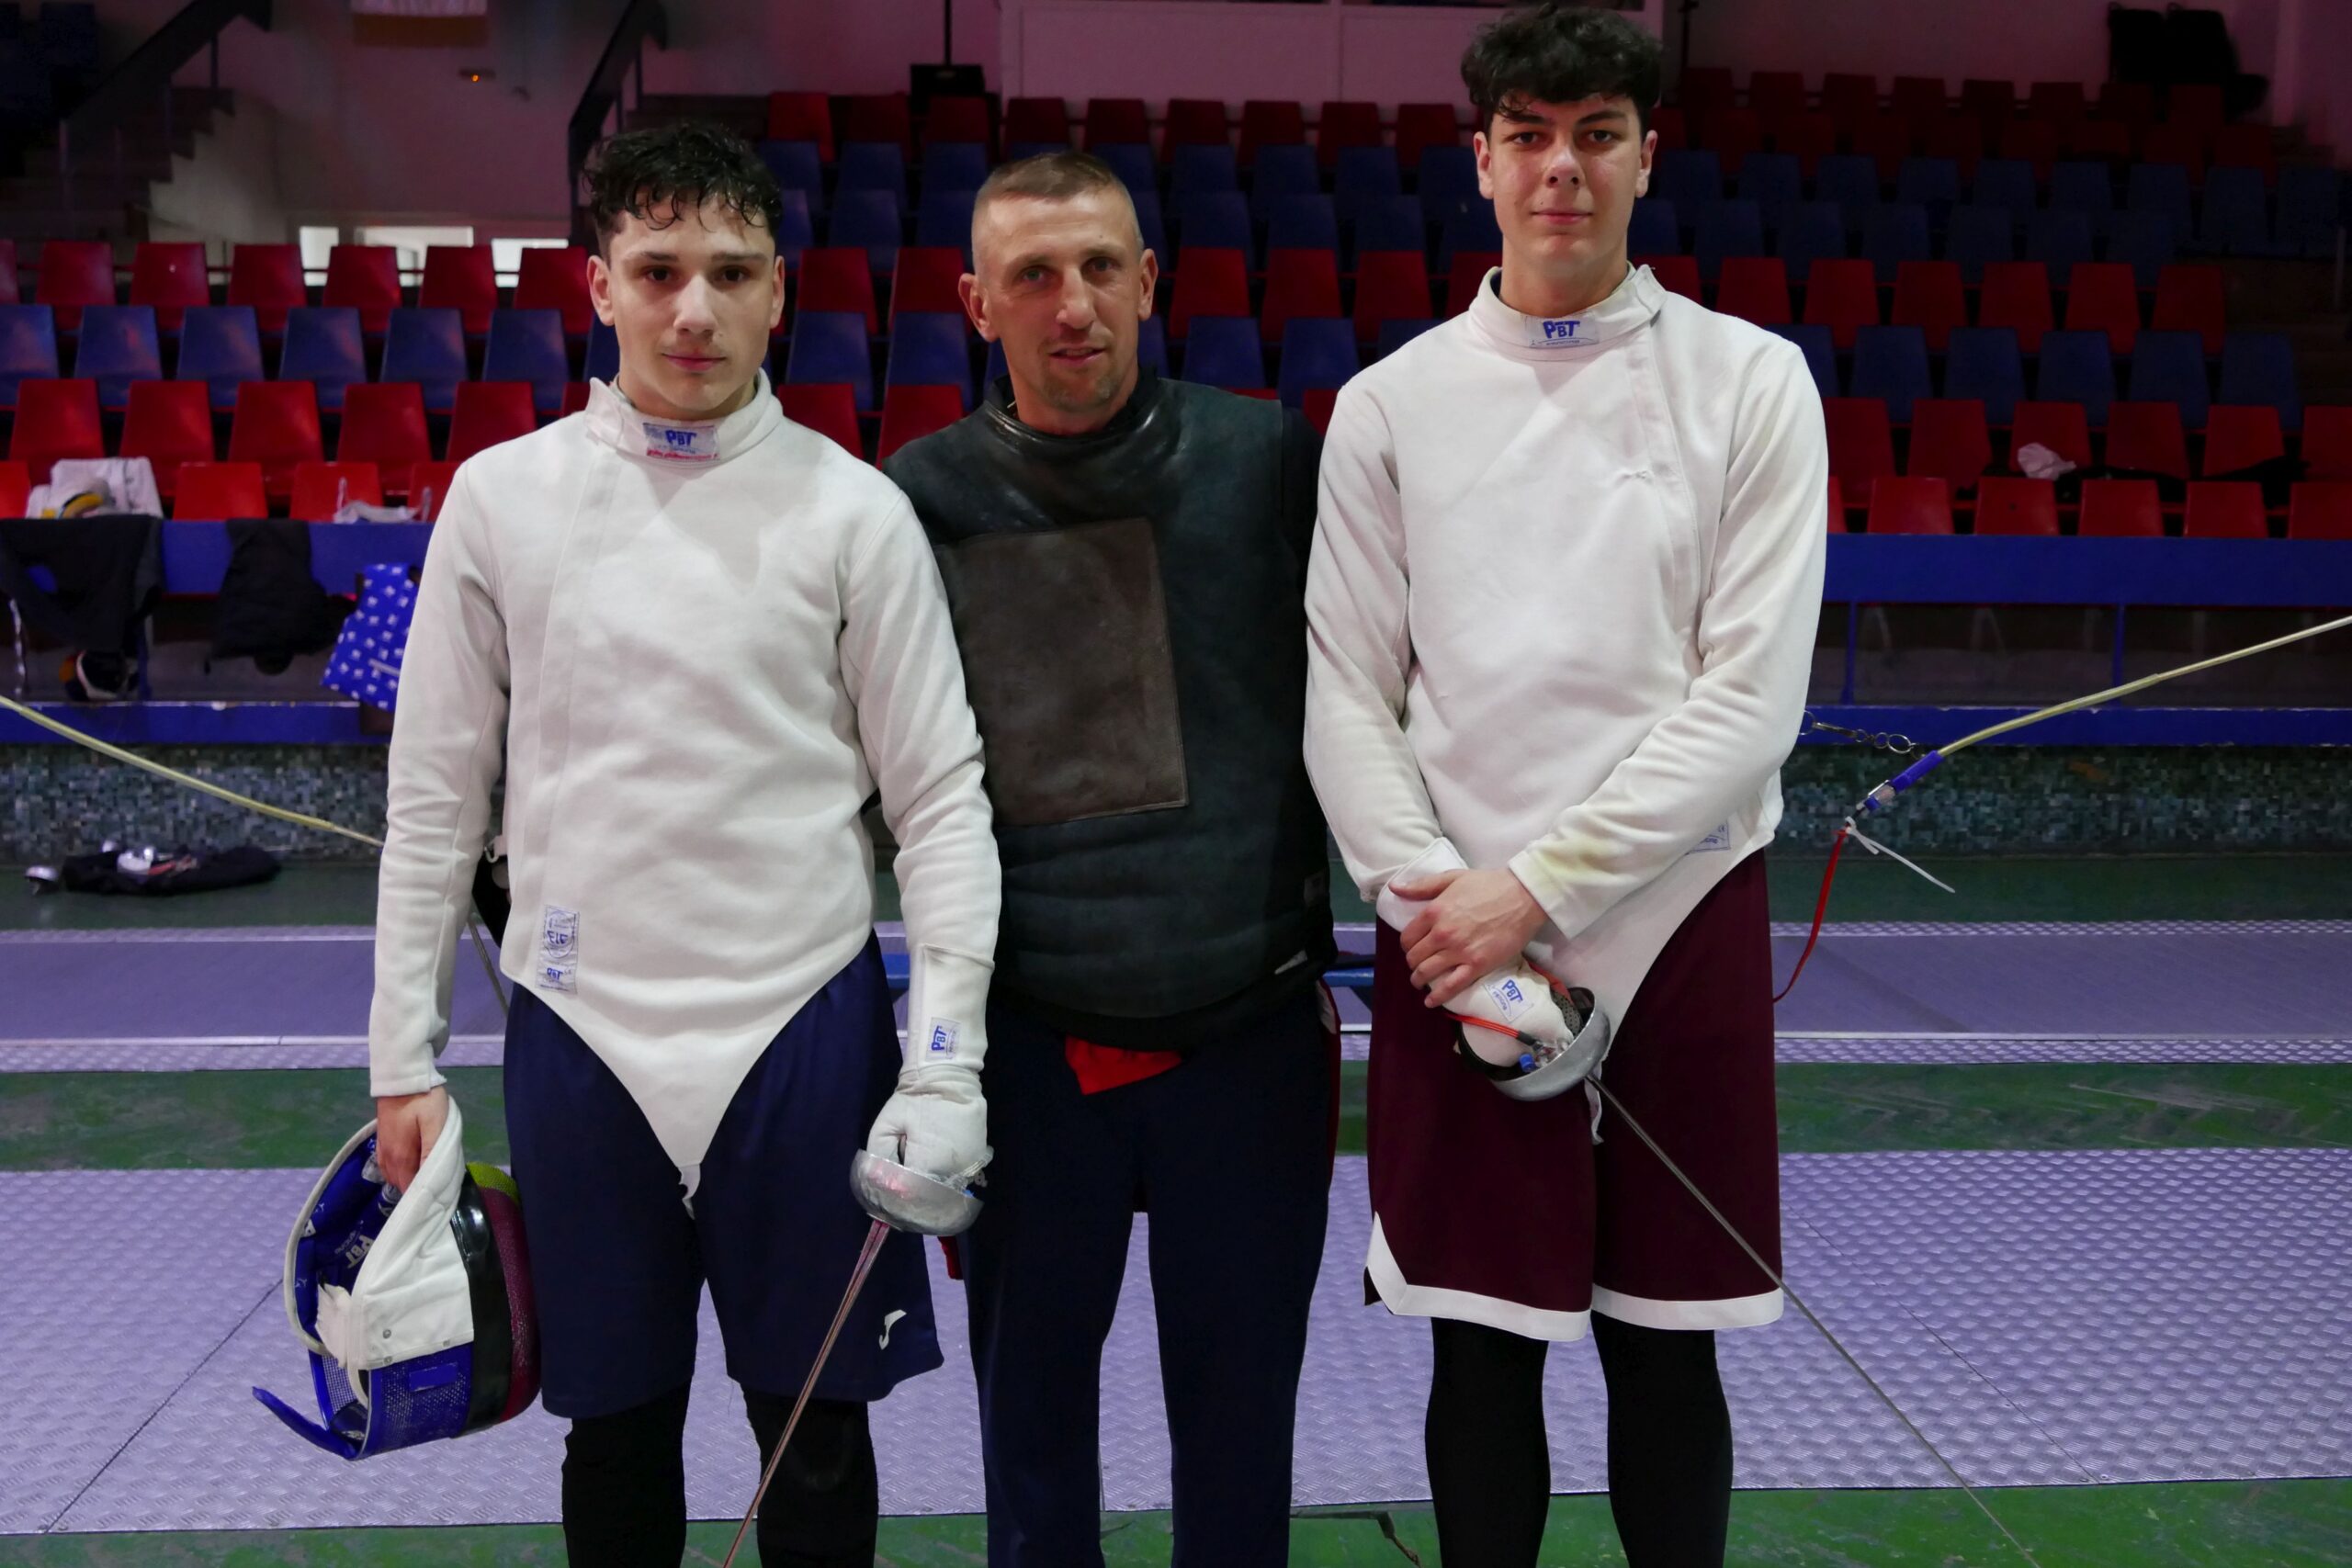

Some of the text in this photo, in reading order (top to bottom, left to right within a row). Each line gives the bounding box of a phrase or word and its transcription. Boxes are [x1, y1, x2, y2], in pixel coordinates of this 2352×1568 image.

[1543, 321, 1580, 339] PBT
[665, 430, 696, 446] PBT
[1501, 979, 1523, 1002] PBT
[931, 1025, 946, 1051] PBT
[345, 1235, 375, 1269] PBT
